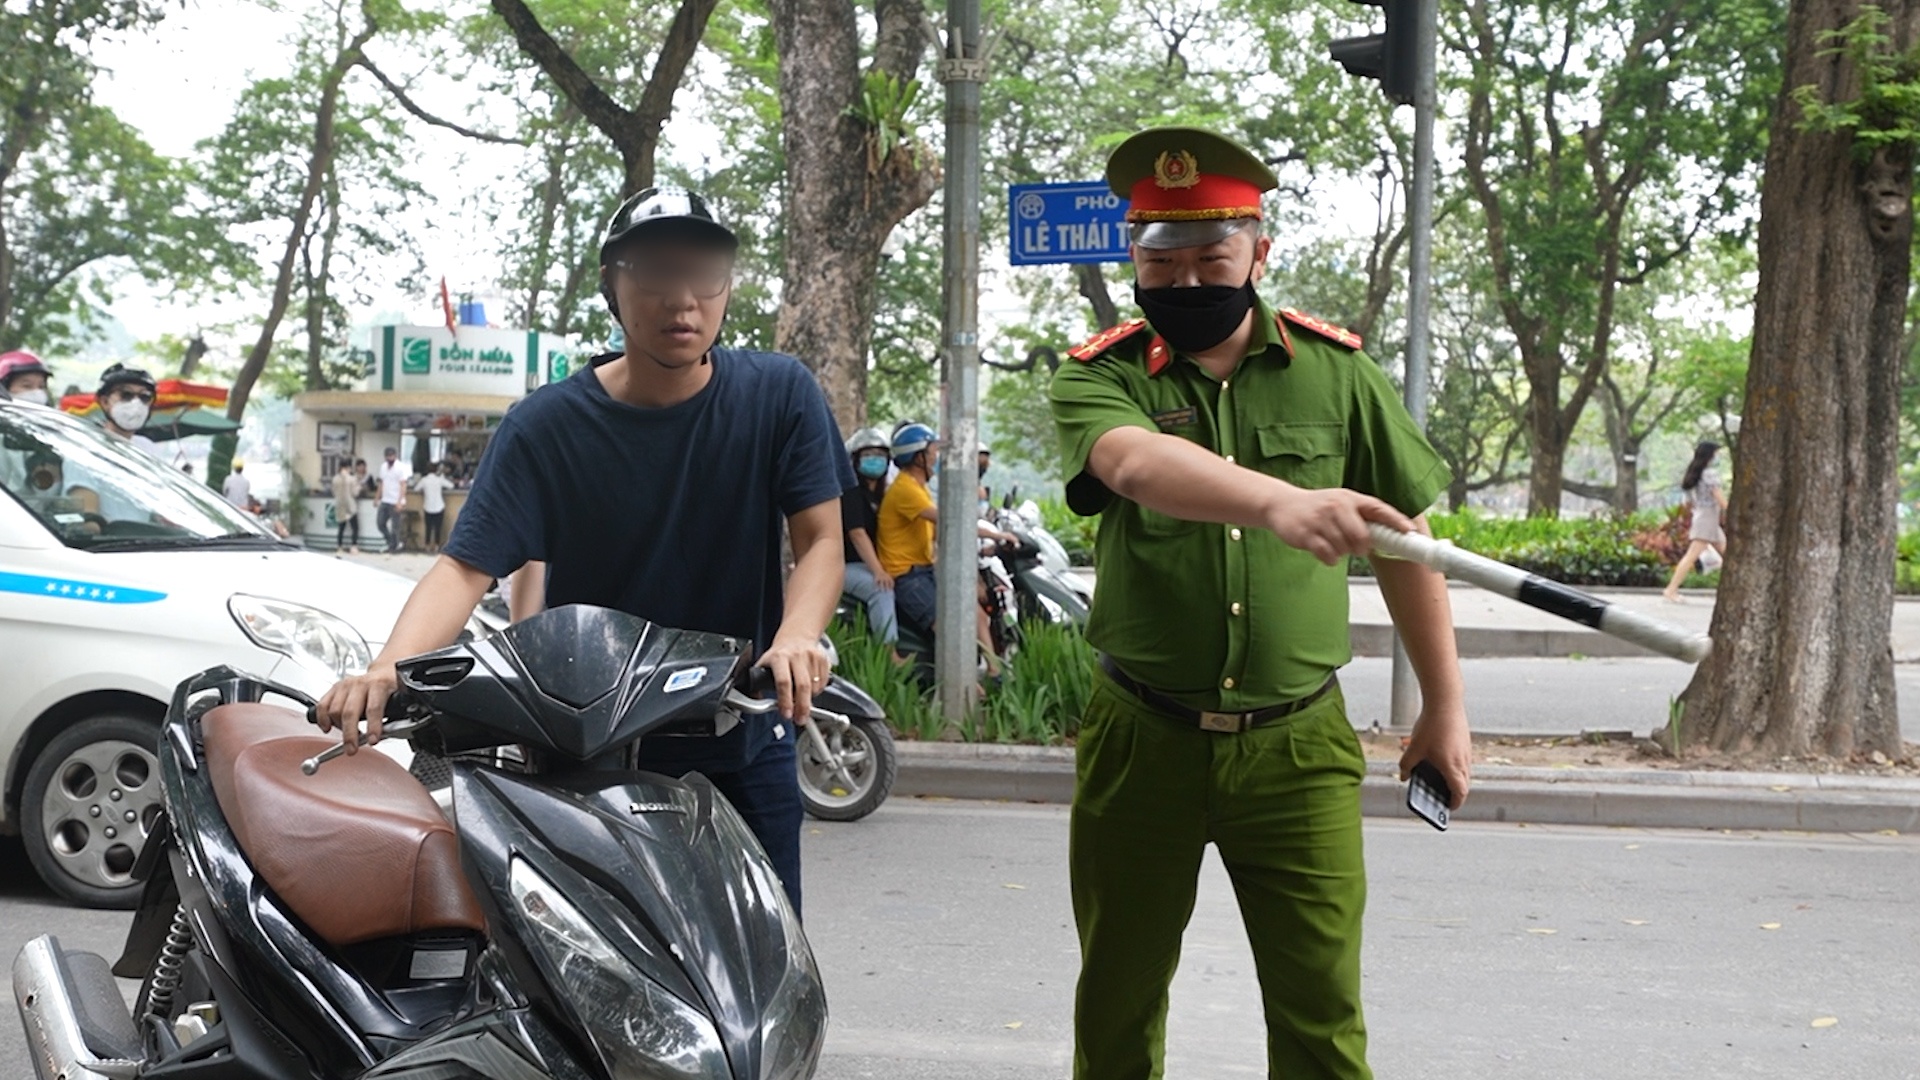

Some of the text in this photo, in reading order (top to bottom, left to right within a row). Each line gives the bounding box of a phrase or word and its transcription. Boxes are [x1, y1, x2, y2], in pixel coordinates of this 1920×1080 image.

[1024, 217, 1130, 253] LÊ THÁI T
